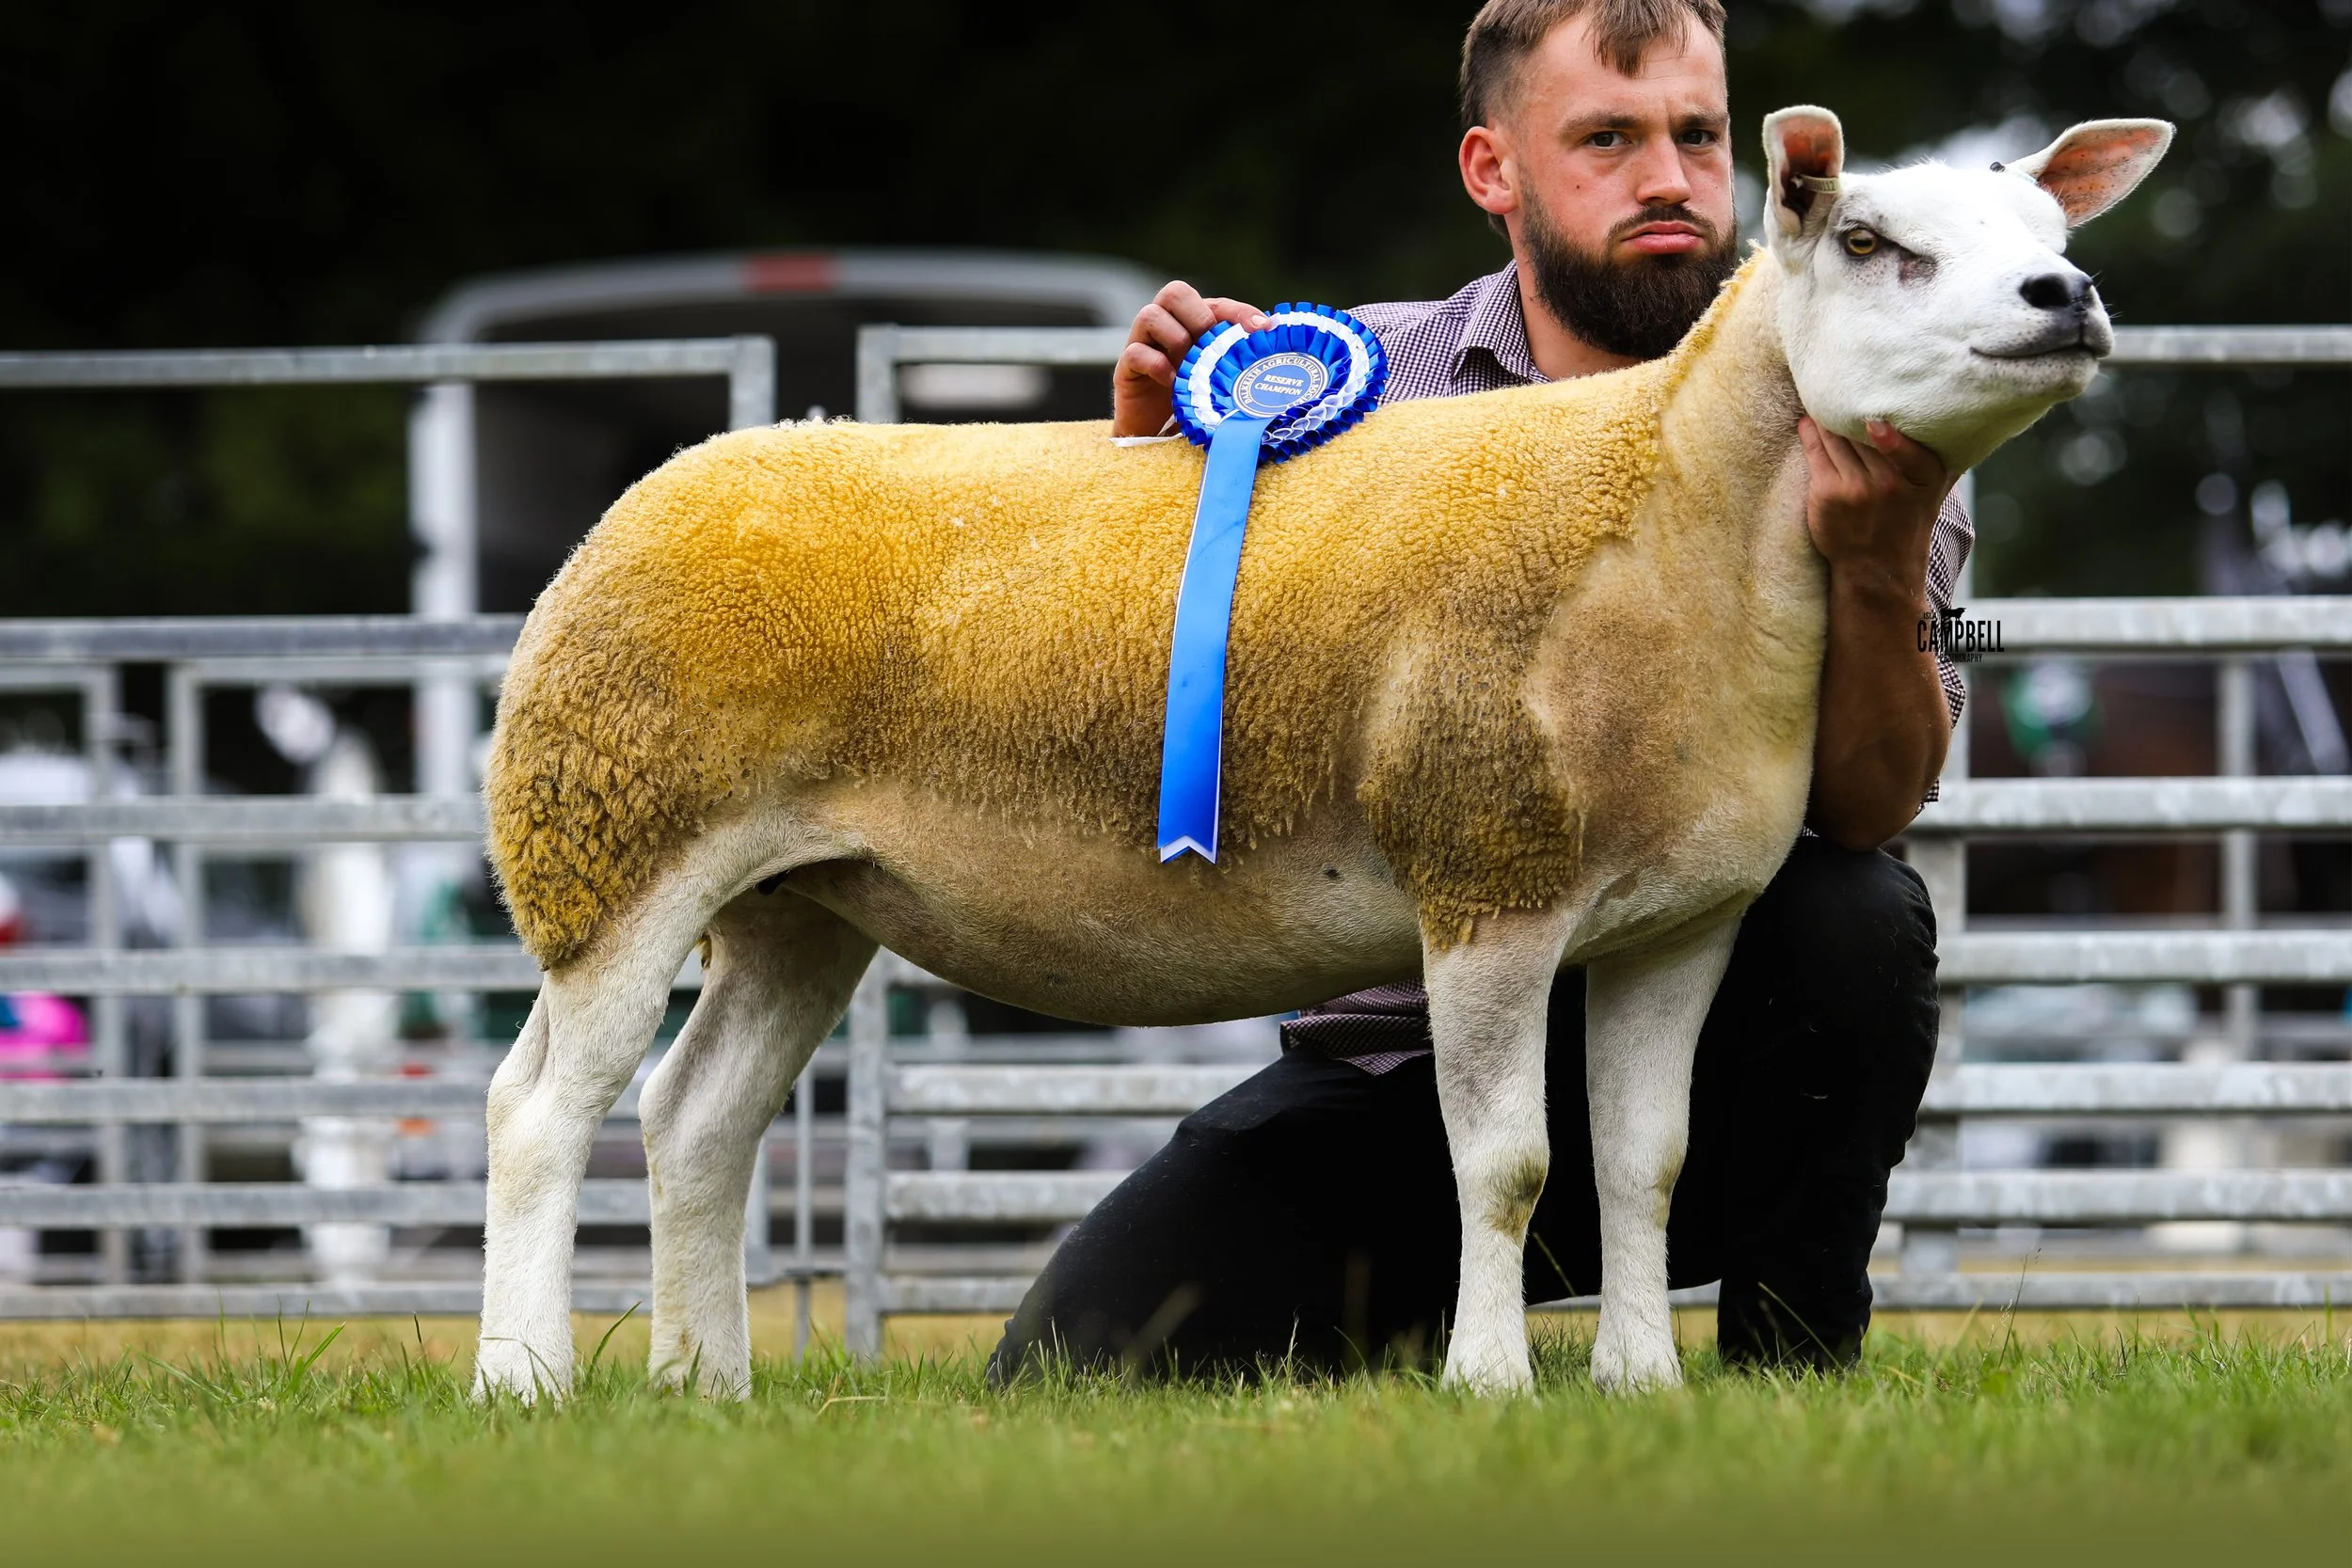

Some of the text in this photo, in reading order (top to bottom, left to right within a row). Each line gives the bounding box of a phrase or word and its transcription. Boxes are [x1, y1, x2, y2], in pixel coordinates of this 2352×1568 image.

[1241, 368, 1262, 404] DALKEITH
[1263, 357, 1320, 383] AGRICULTURAL
[1263, 374, 1304, 387] RESERVE
[1255, 383, 1302, 395] CHAMPION
